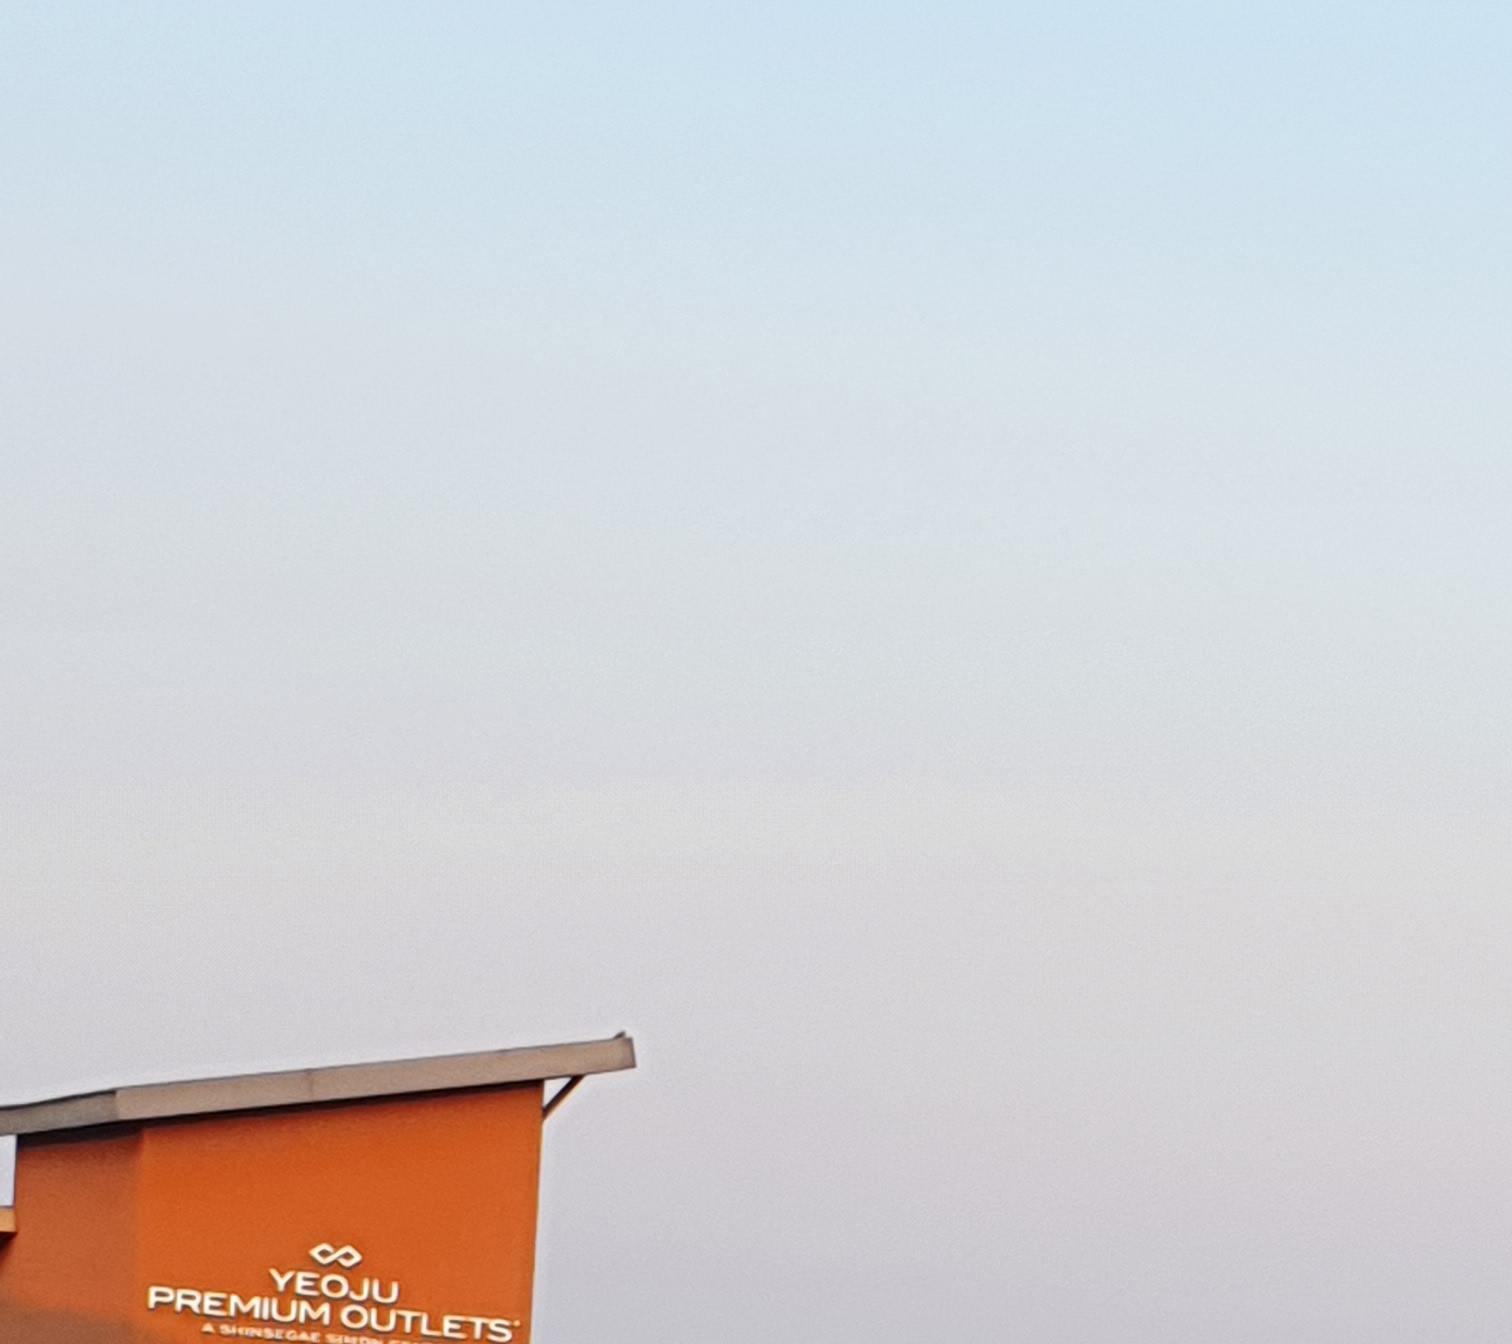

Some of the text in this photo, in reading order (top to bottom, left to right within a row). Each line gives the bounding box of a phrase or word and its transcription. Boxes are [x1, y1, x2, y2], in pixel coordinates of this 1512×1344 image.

[268, 1268, 399, 1303] YEOJU
[148, 1285, 513, 1343] PREMIUM OUTLETS
[201, 1322, 216, 1334] A
